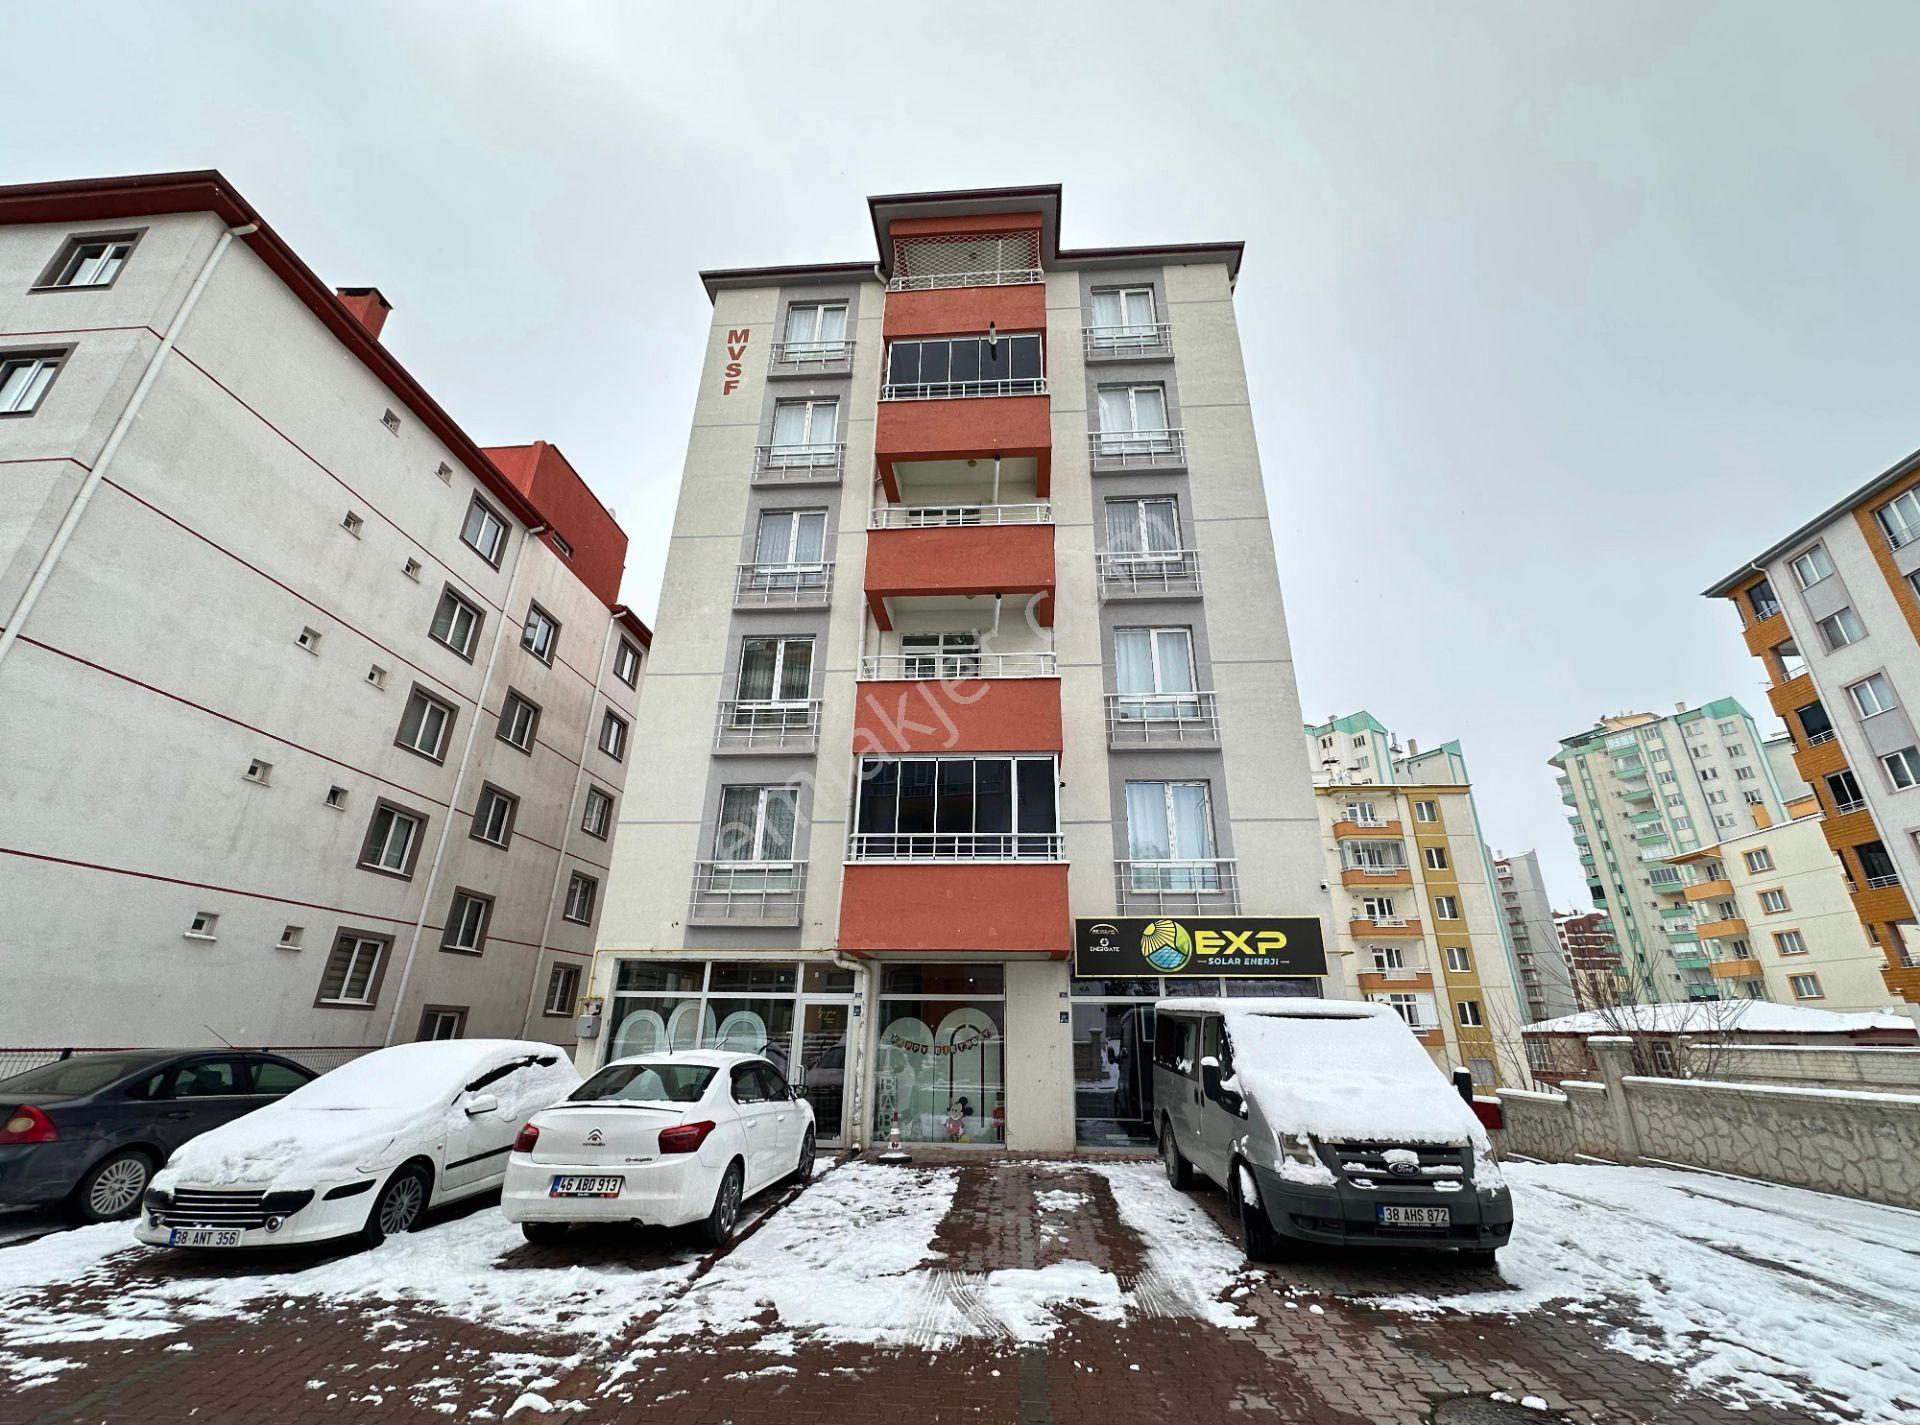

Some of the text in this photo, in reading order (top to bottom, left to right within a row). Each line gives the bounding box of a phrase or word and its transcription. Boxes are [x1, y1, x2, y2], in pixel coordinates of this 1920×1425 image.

[723, 328, 750, 396] MVSF
[1194, 930, 1287, 955] EXP
[1208, 957, 1241, 966] SOLAR
[934, 1029, 990, 1056] BIRTHDY
[560, 1178, 618, 1191] 46 ABD 913
[1385, 1208, 1448, 1222] 38 AHS 872
[175, 1231, 236, 1245] 38 ANT 356
